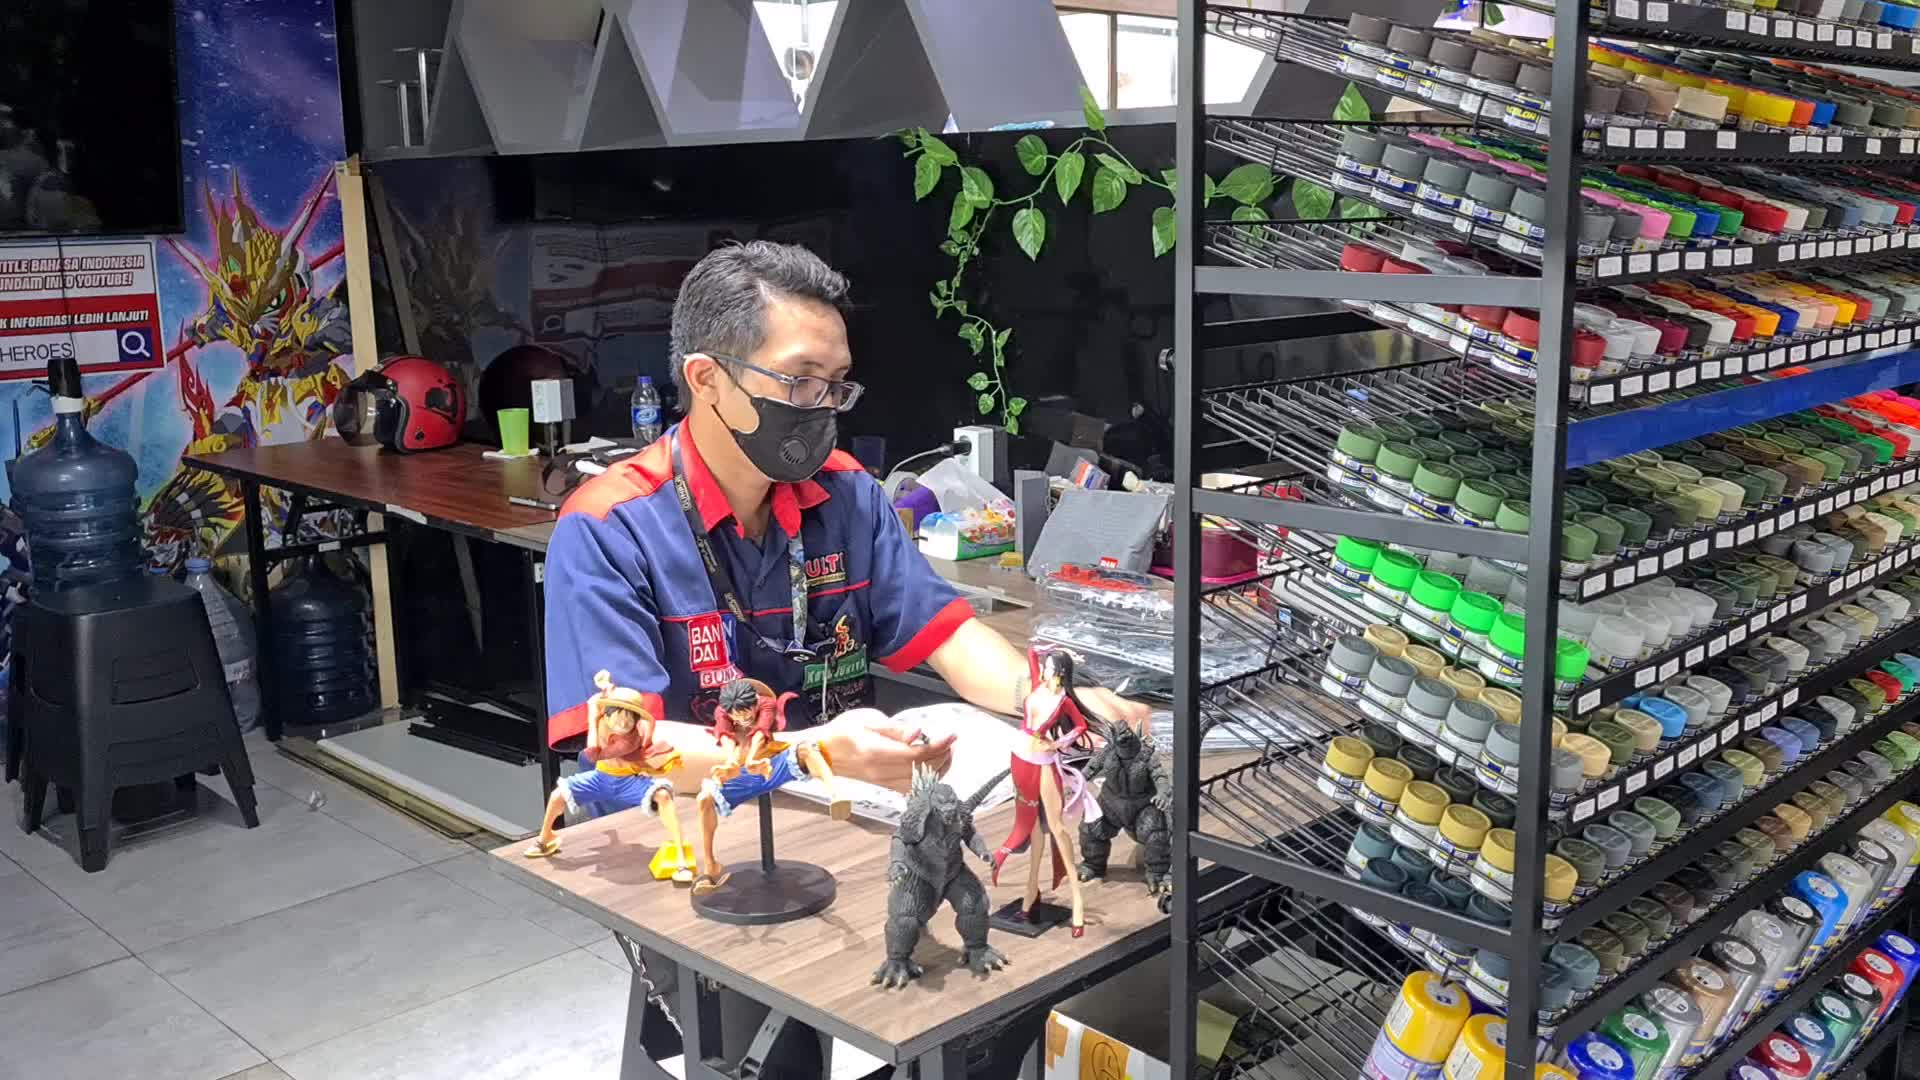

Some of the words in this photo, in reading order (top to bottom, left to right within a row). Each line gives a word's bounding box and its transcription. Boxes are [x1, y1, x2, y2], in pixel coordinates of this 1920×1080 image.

[81, 255, 145, 270] INDONESIA
[45, 273, 74, 290] INO
[76, 272, 133, 288] YOUTUBE!
[10, 315, 72, 328] INFORMASI
[74, 313, 104, 324] LEBIH
[0, 343, 72, 362] HEROES
[691, 623, 721, 645] BAN
[693, 644, 719, 664] DAI
